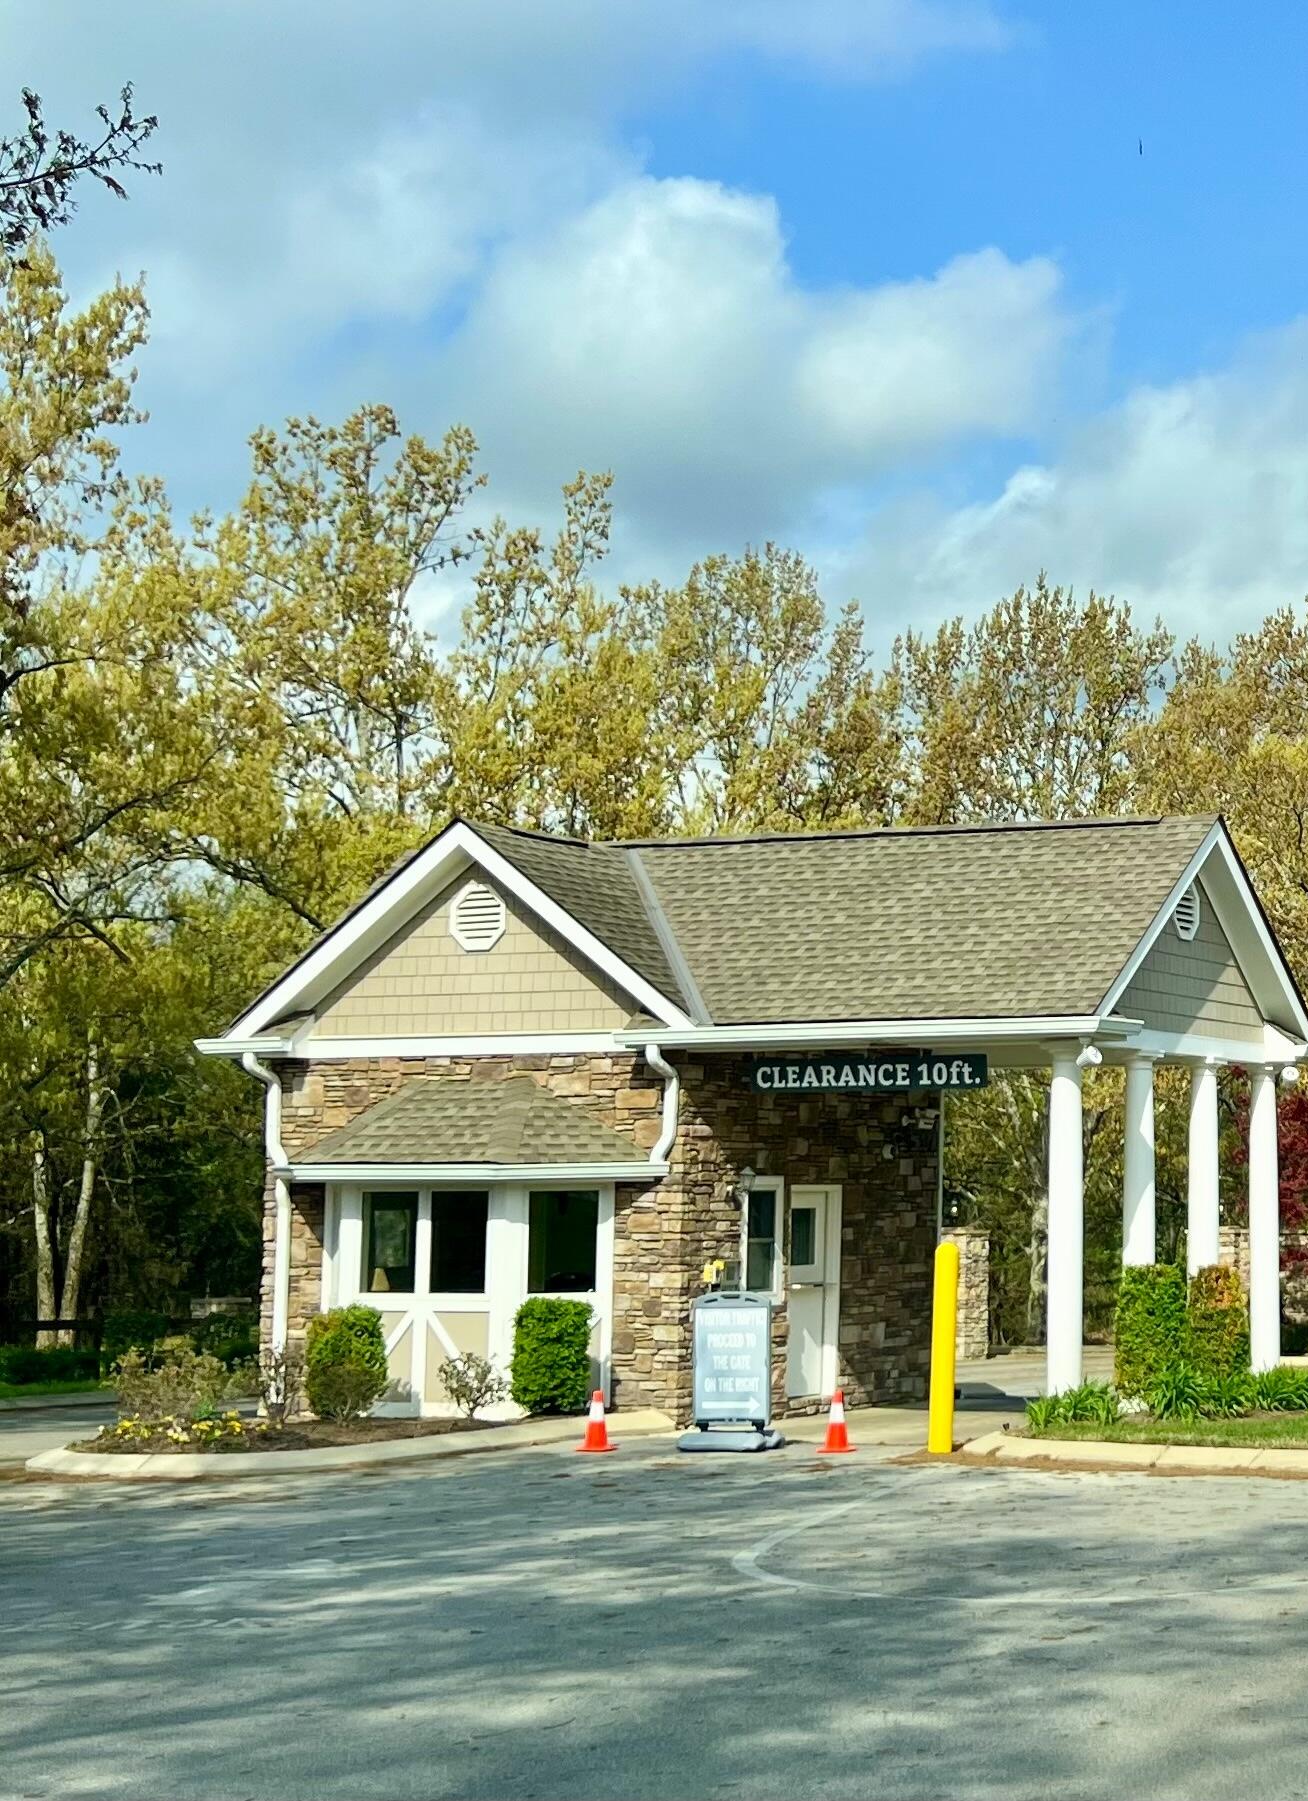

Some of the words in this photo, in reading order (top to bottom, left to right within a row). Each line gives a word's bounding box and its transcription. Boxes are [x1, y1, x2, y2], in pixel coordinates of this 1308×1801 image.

[757, 1063, 910, 1088] CLEARANCE
[917, 1060, 981, 1085] 10ft.
[713, 1355, 729, 1370] THE
[730, 1355, 751, 1370] GATE
[704, 1377, 717, 1392] ON
[718, 1377, 734, 1392] THE
